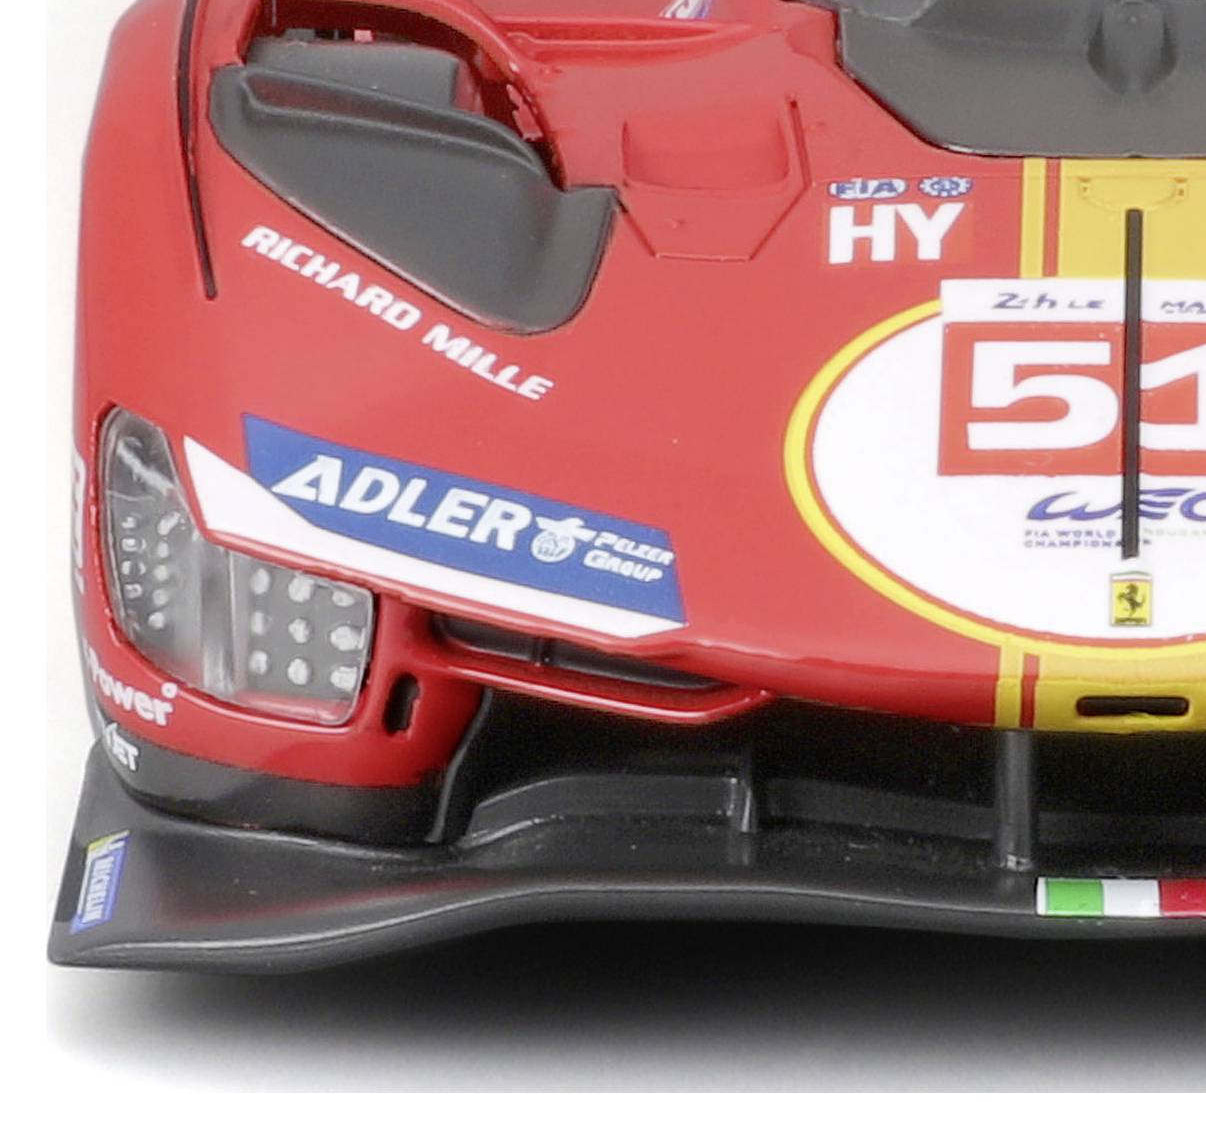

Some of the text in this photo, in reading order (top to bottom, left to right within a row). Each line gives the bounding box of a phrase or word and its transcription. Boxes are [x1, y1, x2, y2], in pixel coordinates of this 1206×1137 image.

[835, 180, 899, 196] FIA
[828, 202, 965, 265] HY
[241, 225, 555, 400] RICHARD MILLE
[272, 454, 533, 552] ADLER
